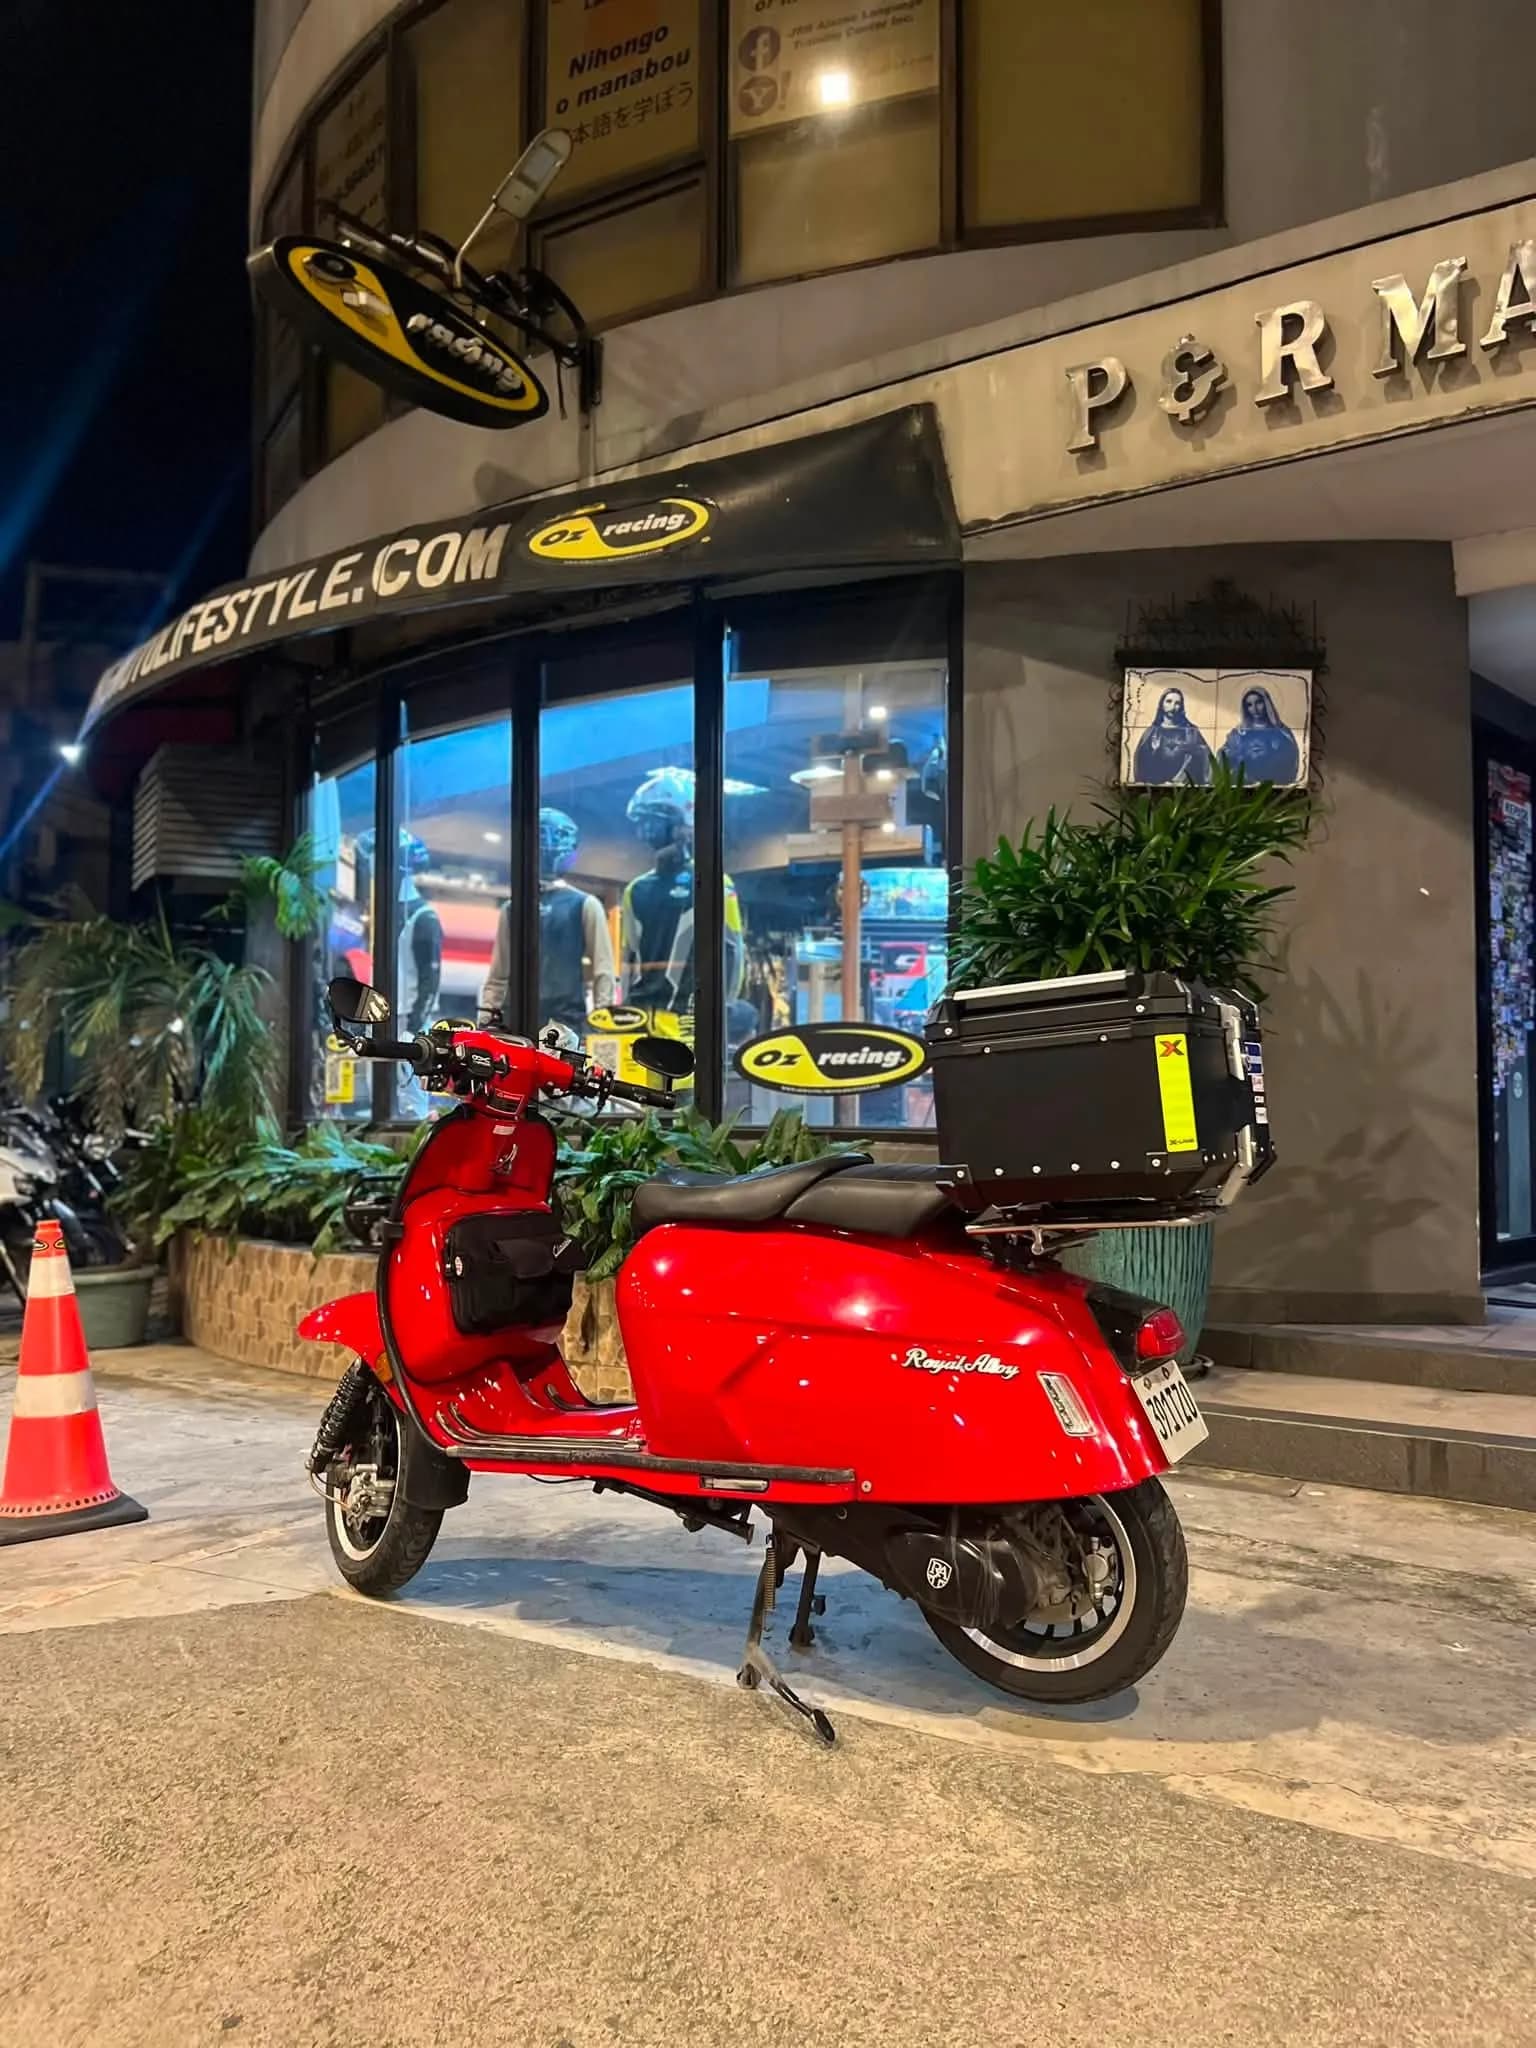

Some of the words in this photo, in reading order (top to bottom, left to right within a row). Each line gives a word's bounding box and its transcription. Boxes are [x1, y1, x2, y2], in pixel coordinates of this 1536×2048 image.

[568, 25, 669, 78] Nihongo
[555, 98, 569, 115] o
[577, 48, 691, 107] manabou
[570, 81, 694, 144] 本語を学ぼう
[1066, 357, 1131, 454] P
[1254, 300, 1335, 408] R
[539, 528, 591, 546] Oz
[602, 513, 687, 536] racing
[753, 1050, 803, 1066] Oz
[817, 1046, 903, 1068] racing
[901, 1347, 966, 1374] Royal
[963, 1353, 1020, 1380] Alloy
